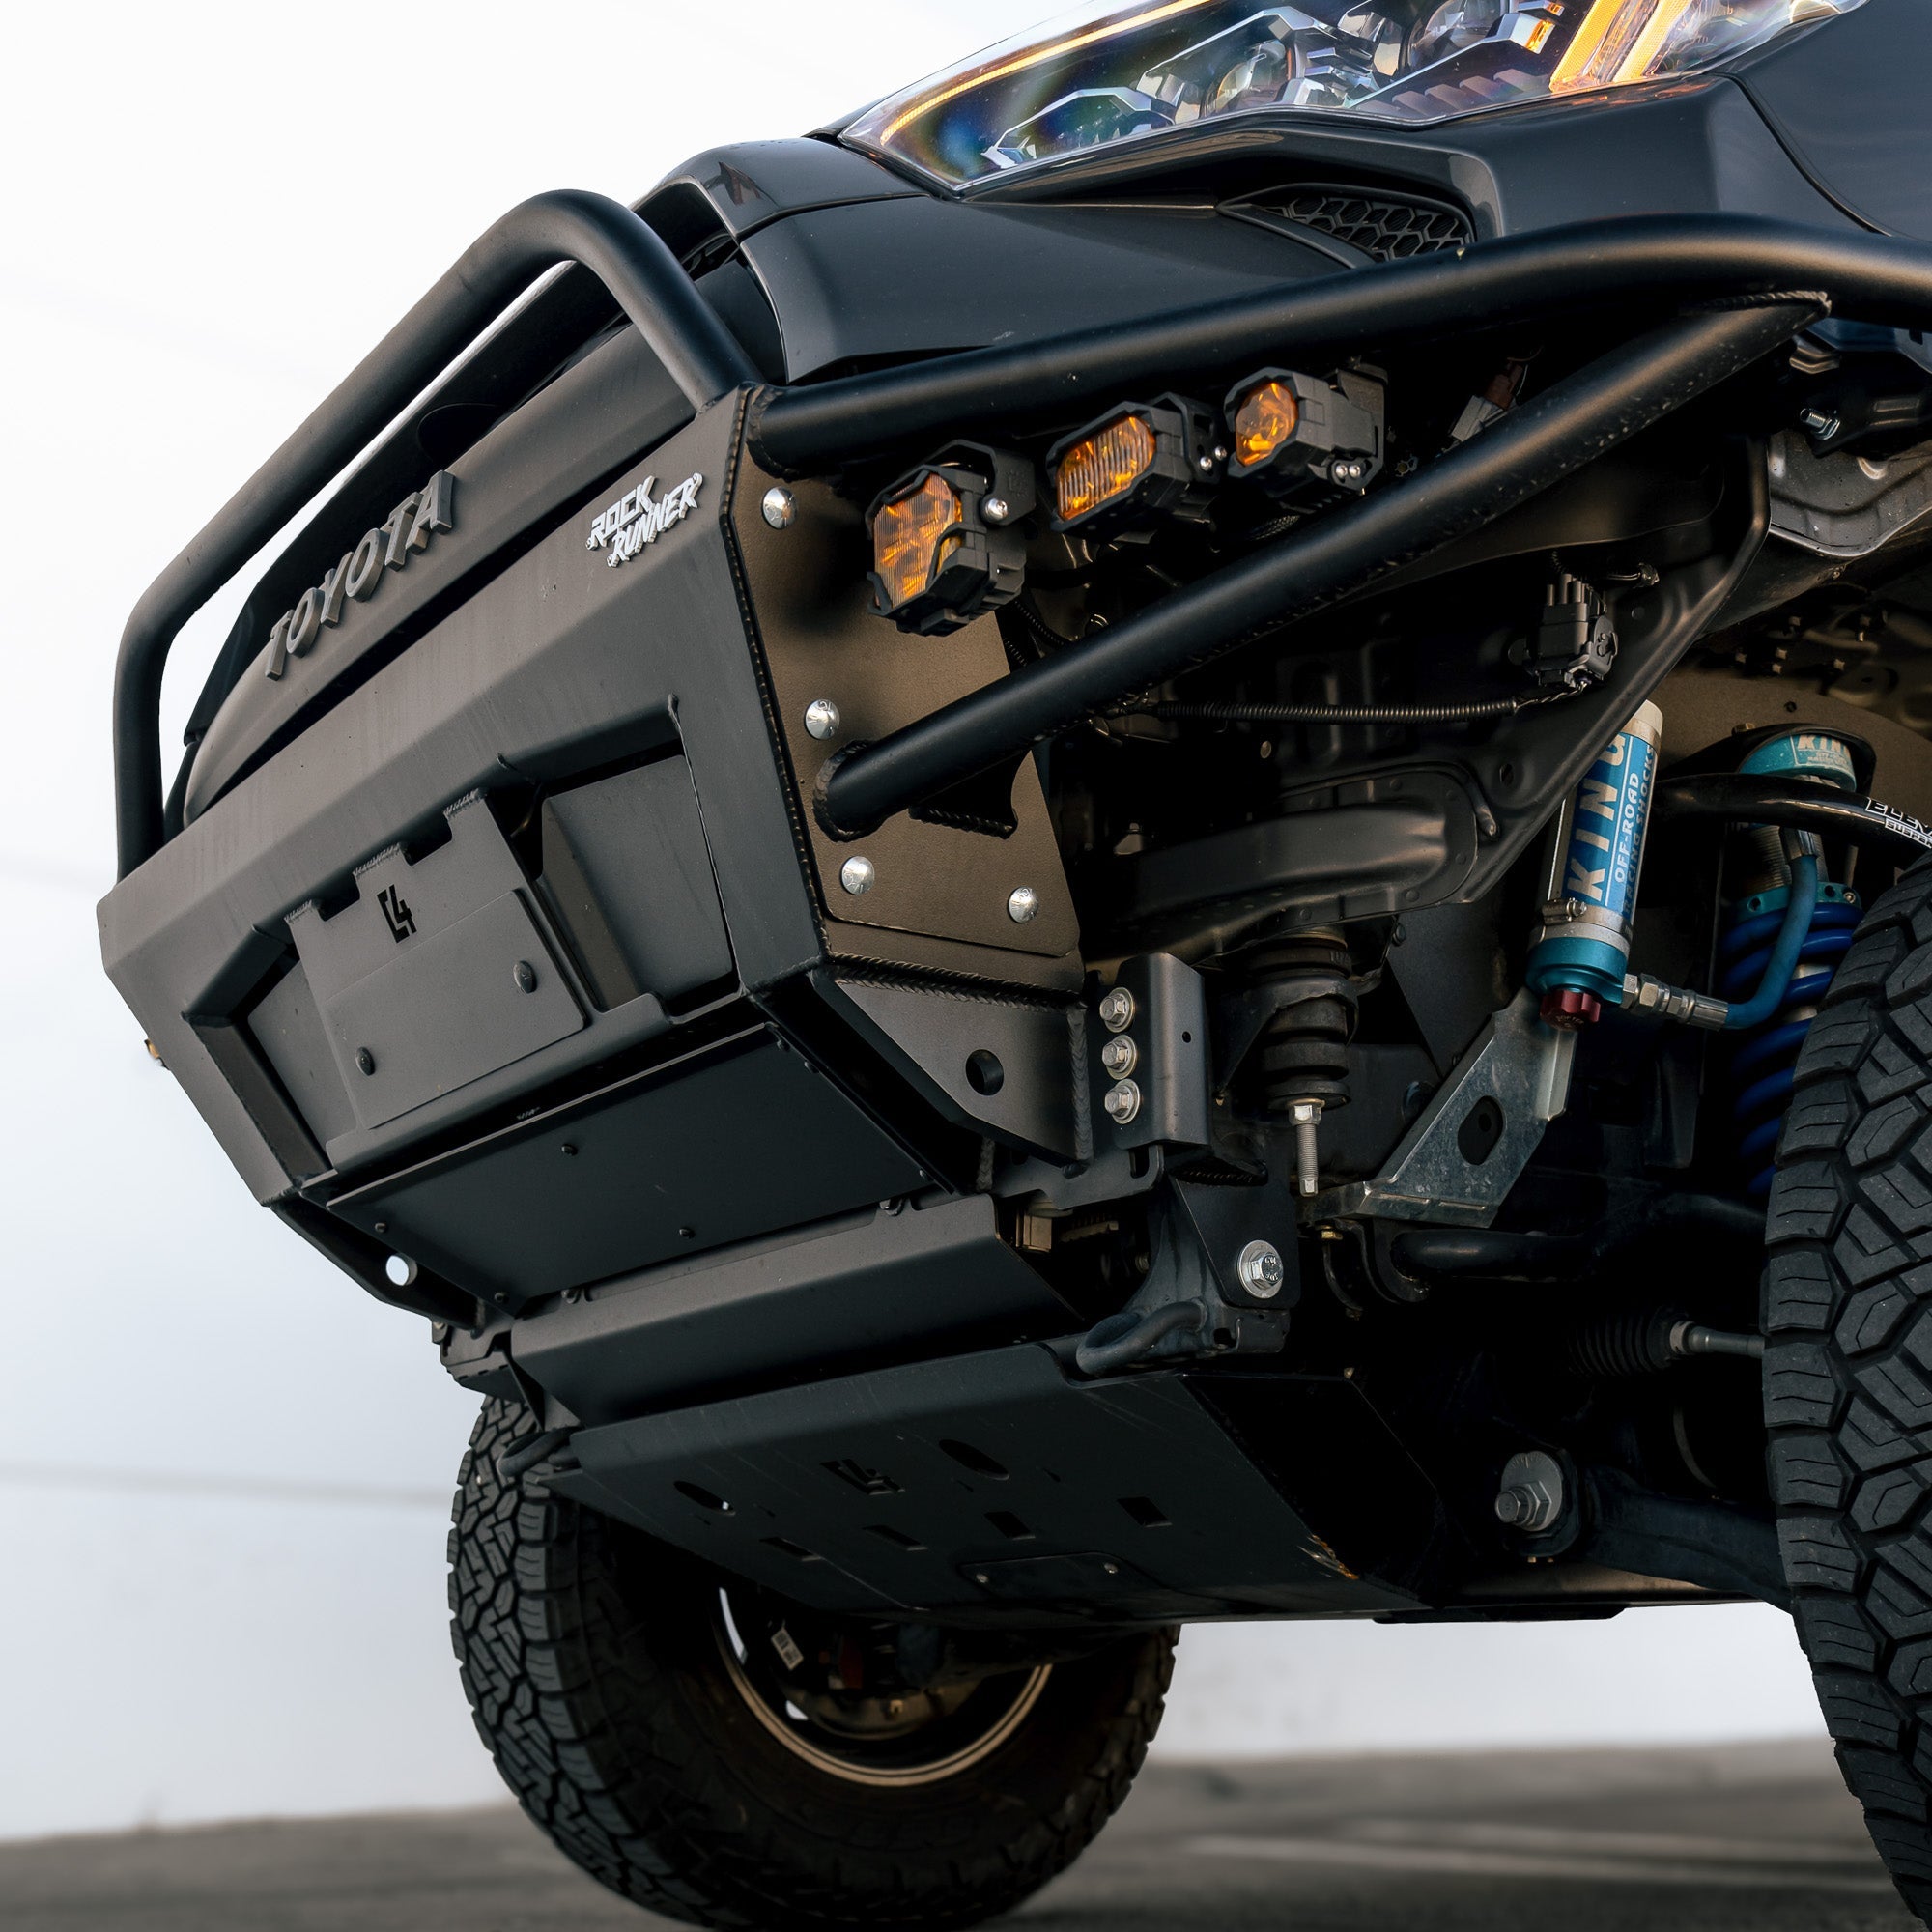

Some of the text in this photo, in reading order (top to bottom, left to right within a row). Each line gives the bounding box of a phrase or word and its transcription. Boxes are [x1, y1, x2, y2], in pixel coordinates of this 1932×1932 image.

[585, 475, 656, 551] ROCK
[607, 472, 703, 567] RUNNER
[265, 469, 456, 681] TOYOTA
[1615, 772, 1640, 884] OFF-ROAD
[1624, 744, 1656, 915] RACING SHOCKS
